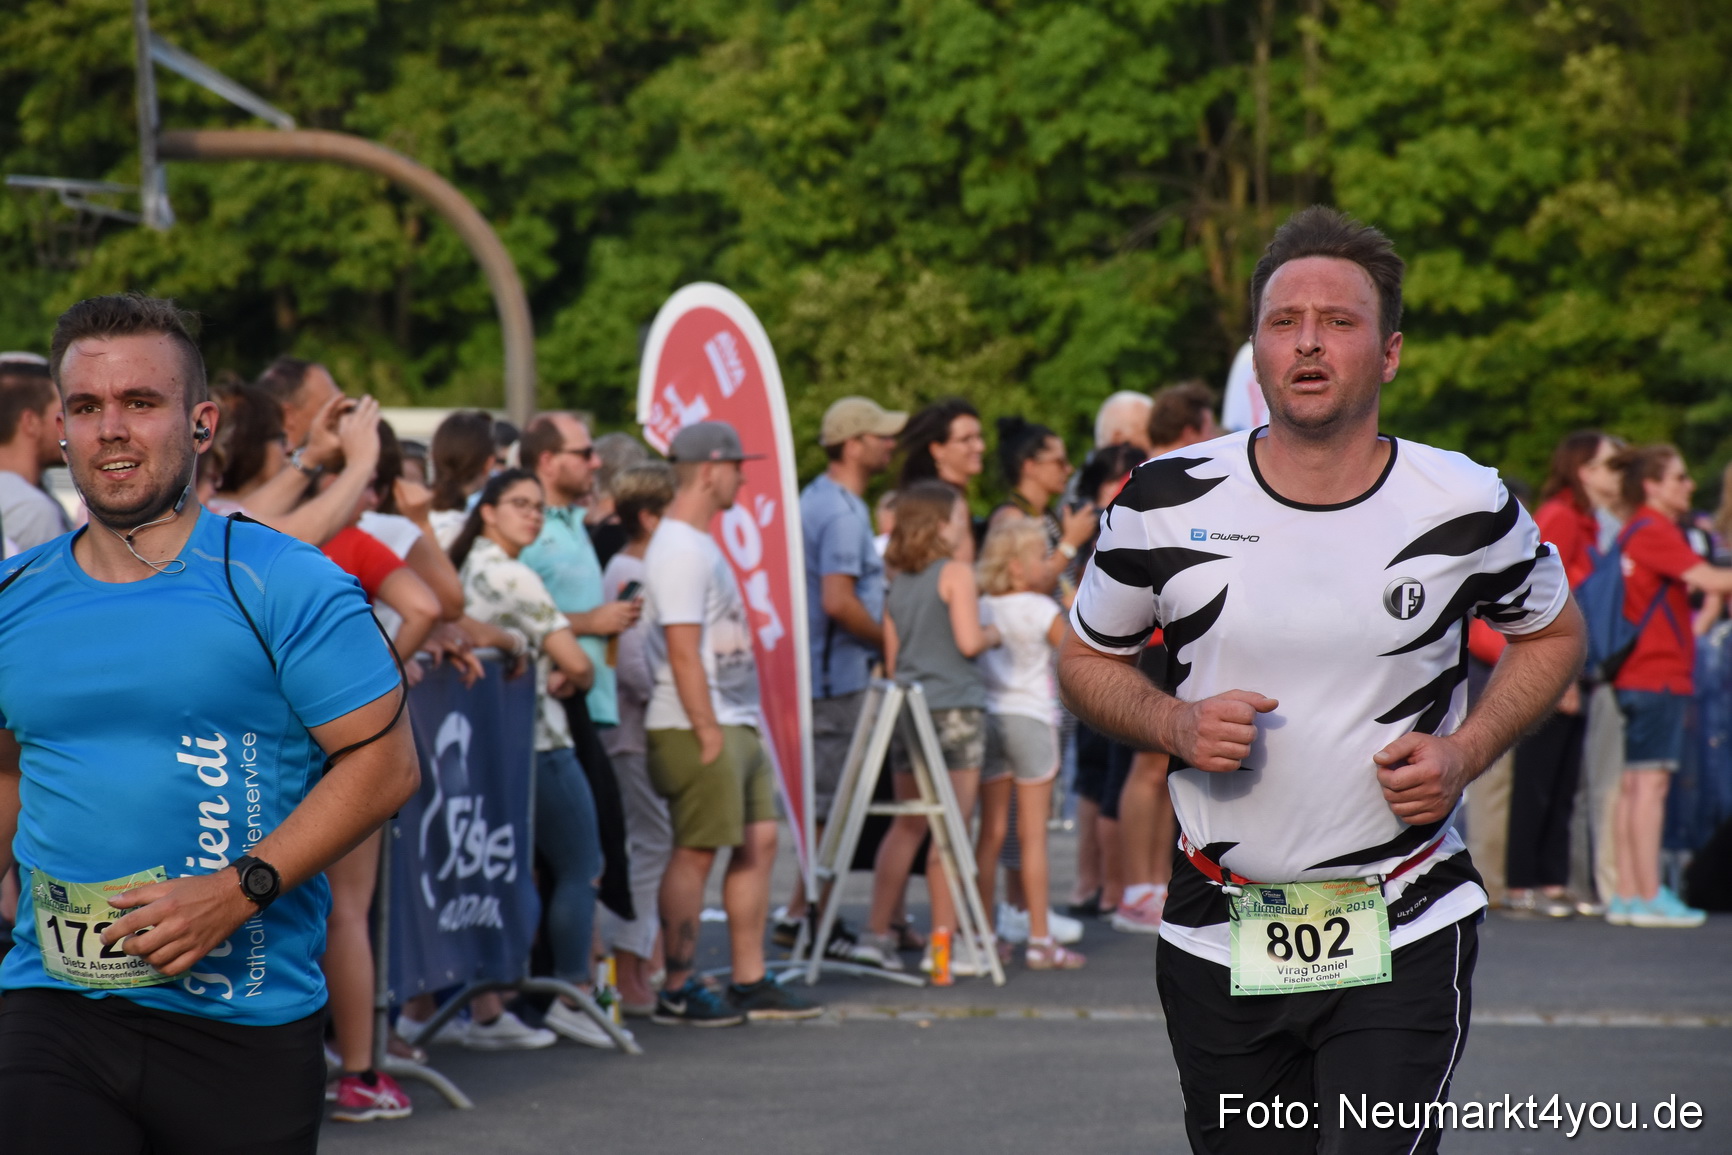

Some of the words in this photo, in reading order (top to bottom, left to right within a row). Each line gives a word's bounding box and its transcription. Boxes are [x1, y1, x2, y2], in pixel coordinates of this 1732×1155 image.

[176, 732, 229, 788] di
[43, 894, 91, 915] firmenlauf
[1253, 901, 1309, 916] firmenlauf
[1346, 899, 1375, 913] 2019
[47, 915, 151, 959] 172
[1266, 917, 1354, 963] 802
[62, 956, 87, 970] Dietz
[1276, 964, 1309, 977] Virag
[1311, 960, 1348, 974] Daniel
[66, 968, 94, 979] Nathalie
[96, 969, 150, 981] Lengenfelder
[1283, 975, 1314, 984] Fischer
[1316, 972, 1341, 981] GmbH
